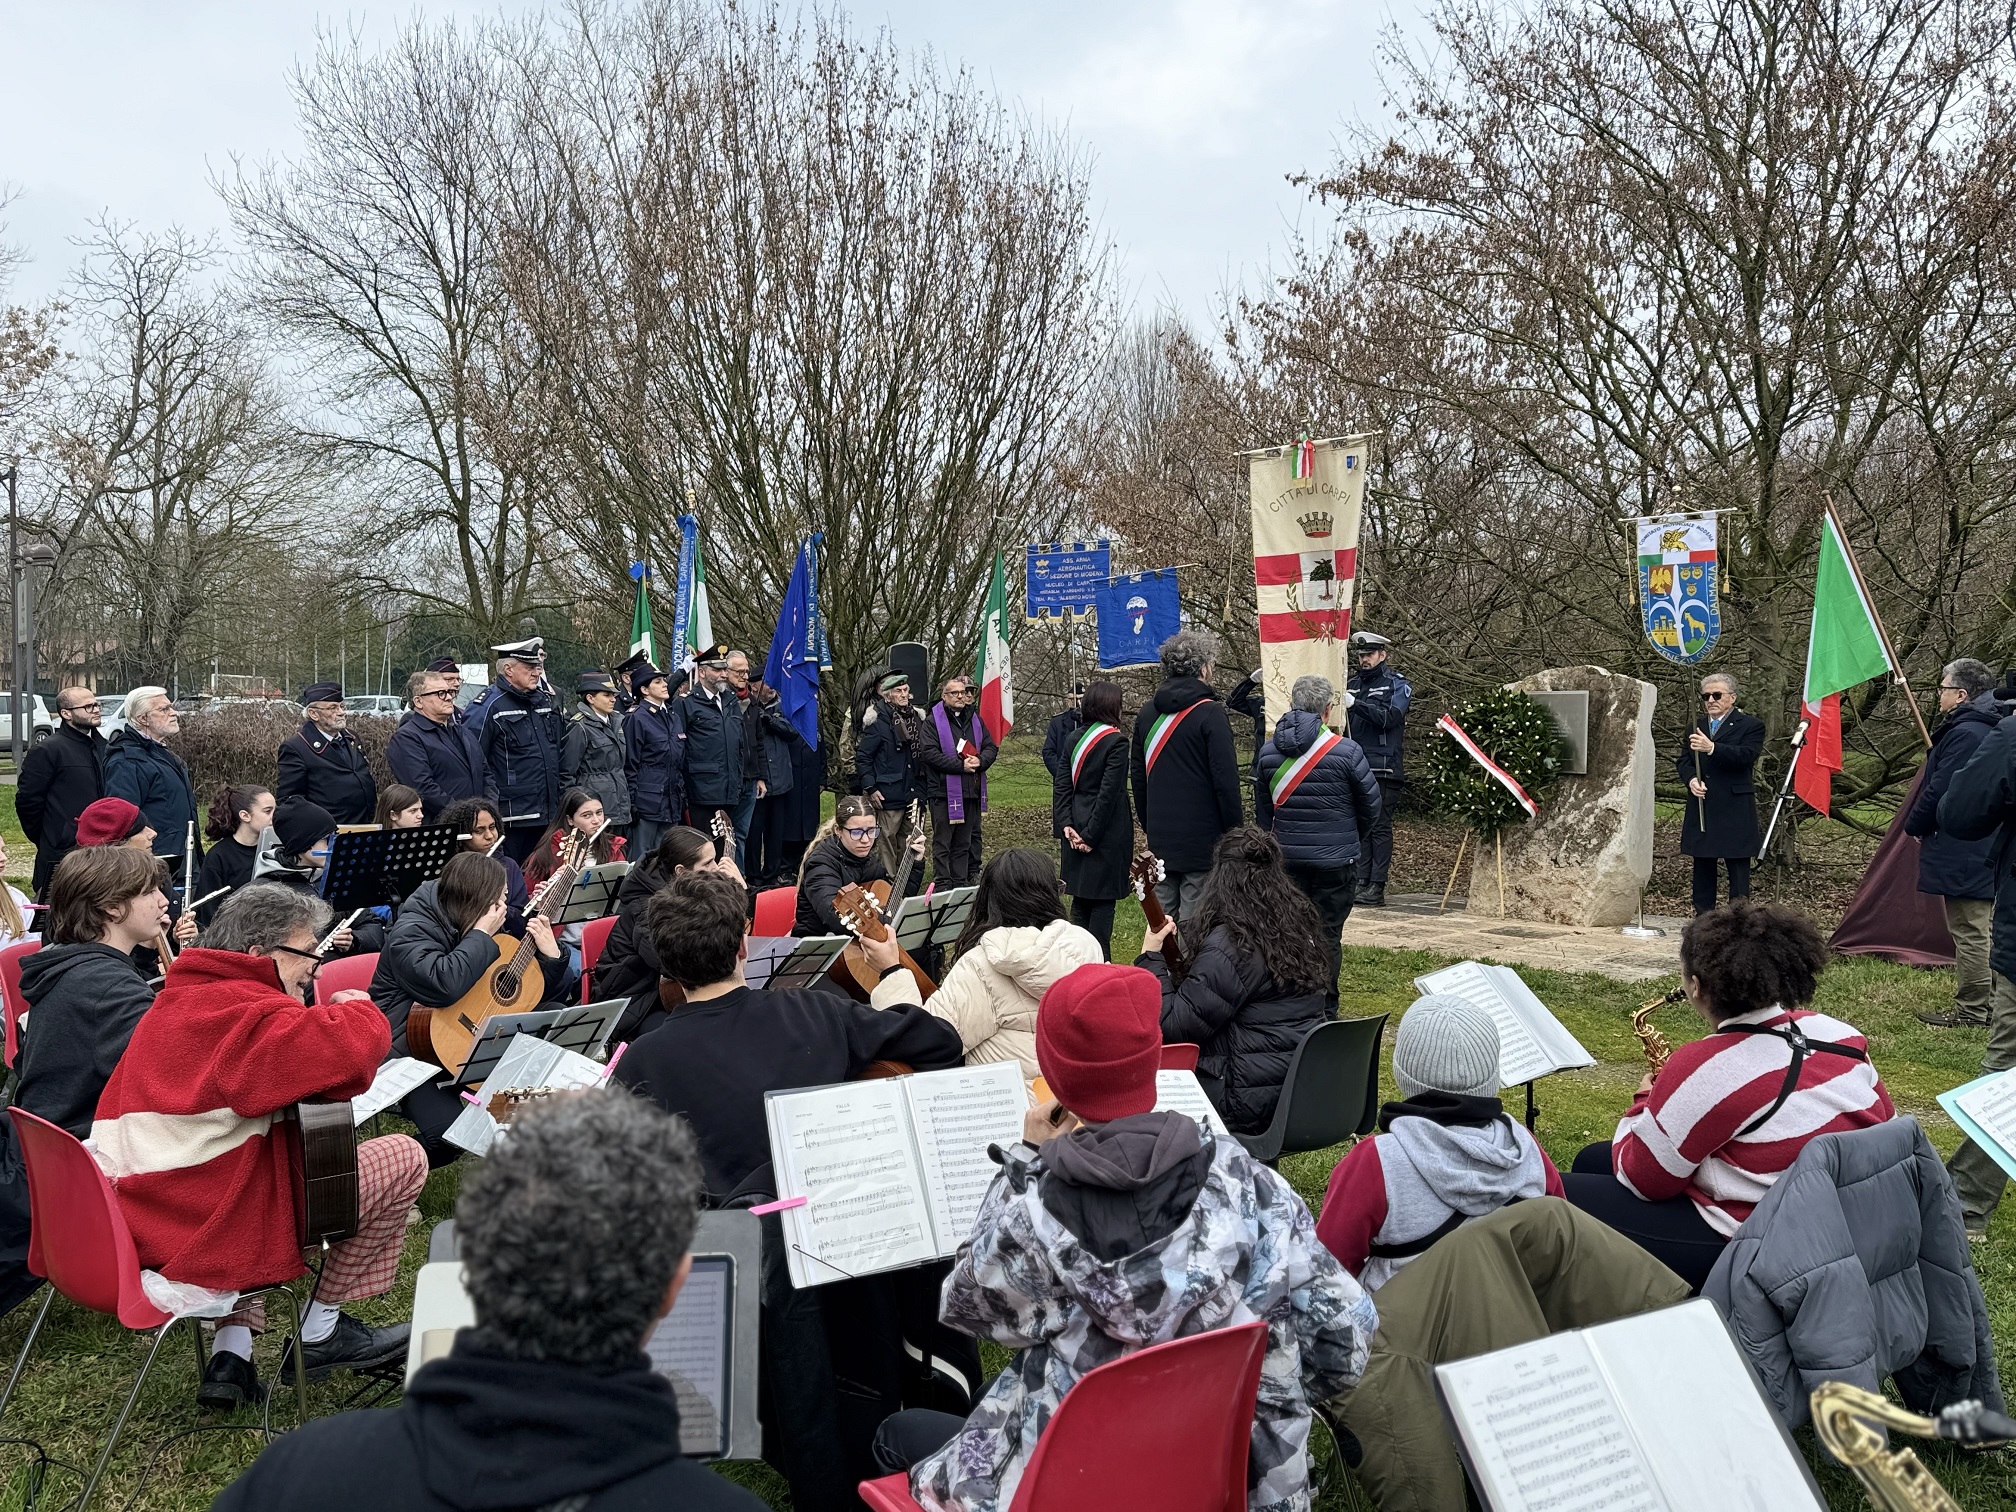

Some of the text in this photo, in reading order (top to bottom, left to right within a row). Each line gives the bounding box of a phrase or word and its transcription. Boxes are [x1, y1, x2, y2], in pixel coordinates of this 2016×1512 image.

[1307, 483, 1318, 495] DI
[1321, 482, 1351, 505] CARPI
[1639, 526, 1661, 546] COMITATO
[1696, 525, 1715, 543] MODENA
[1058, 564, 1096, 572] AERONAUTICA
[674, 537, 689, 673] SOCIAZIONE NAZIONALE CARABINIERI
[1696, 634, 1719, 658] GIULIA
[1708, 565, 1719, 616] DALMAZIA
[1119, 637, 1155, 648] CARPI
